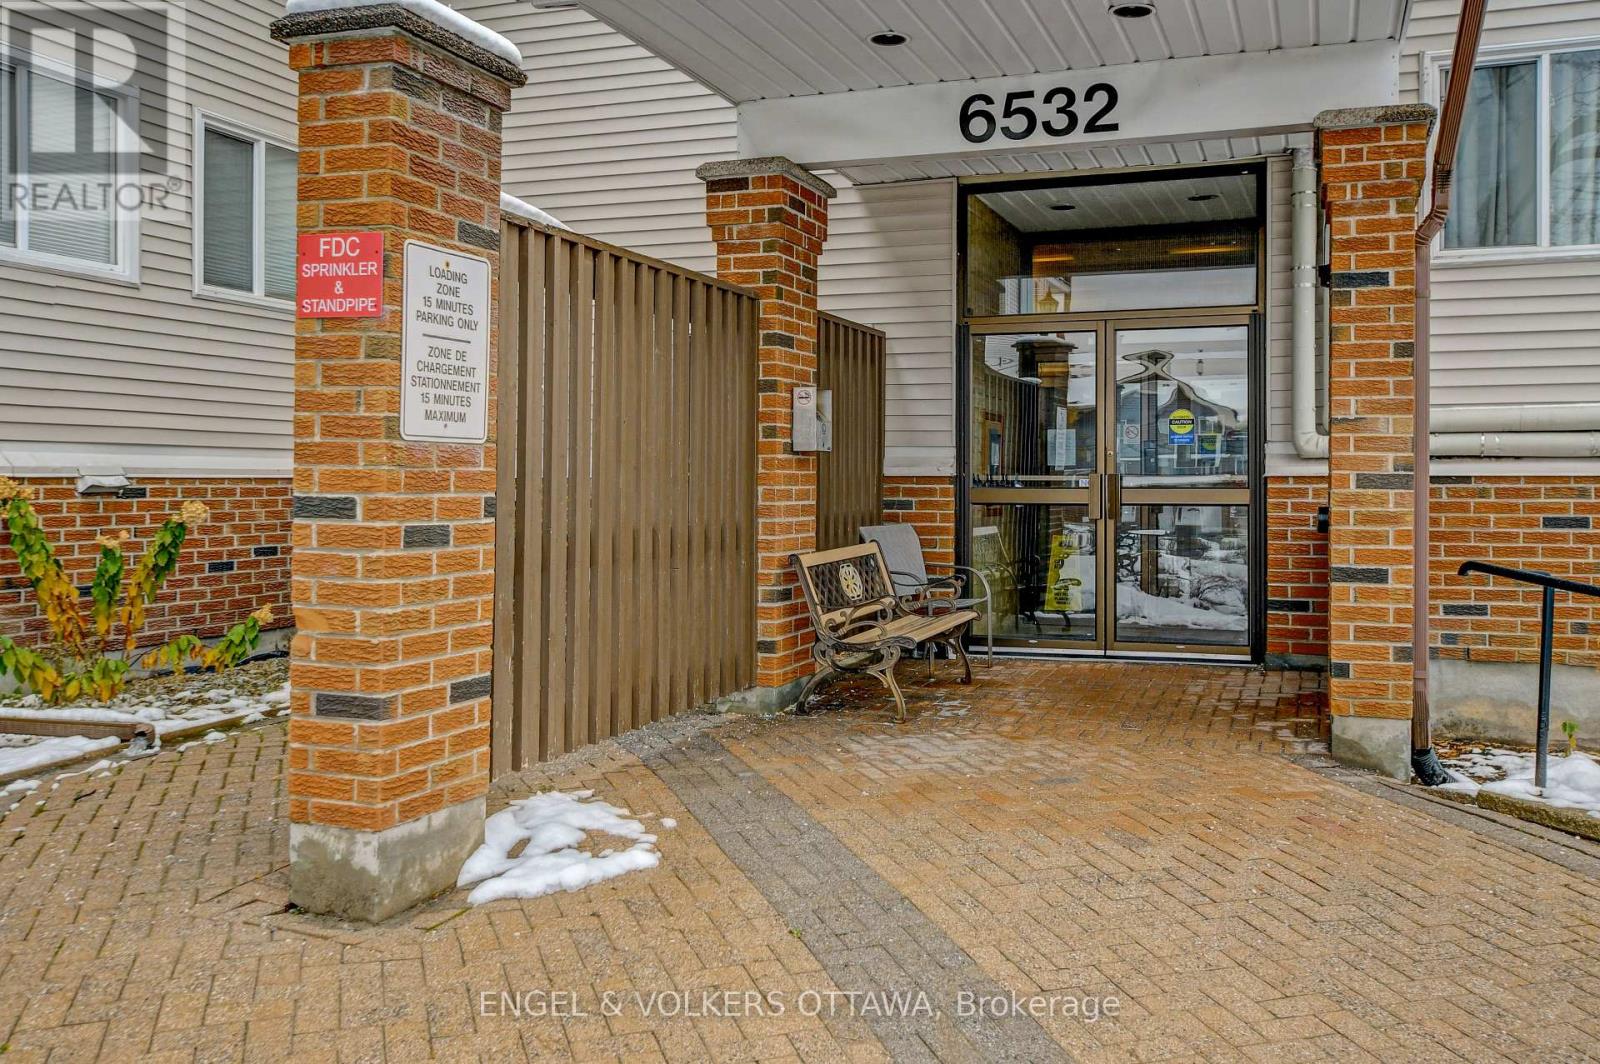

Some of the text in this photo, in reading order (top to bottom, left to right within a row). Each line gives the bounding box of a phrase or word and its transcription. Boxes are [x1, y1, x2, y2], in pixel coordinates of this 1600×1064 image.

[959, 82, 1119, 144] 6532
[319, 236, 360, 257] FDC
[302, 261, 378, 277] SPRINKLER
[429, 265, 468, 284] LOADING
[334, 280, 344, 294] &
[436, 283, 461, 298] ZONE
[302, 298, 377, 313] STANDPIPE
[422, 296, 474, 316] 15 MINUTES
[416, 310, 479, 331] PARKING ONLY
[428, 346, 467, 362] ZONE DE
[416, 360, 476, 378] CHARGEMENT
[410, 375, 481, 393] STATIONNEMENT
[420, 392, 472, 408] 15 MINUTES
[424, 409, 467, 423] MAXIMUM
